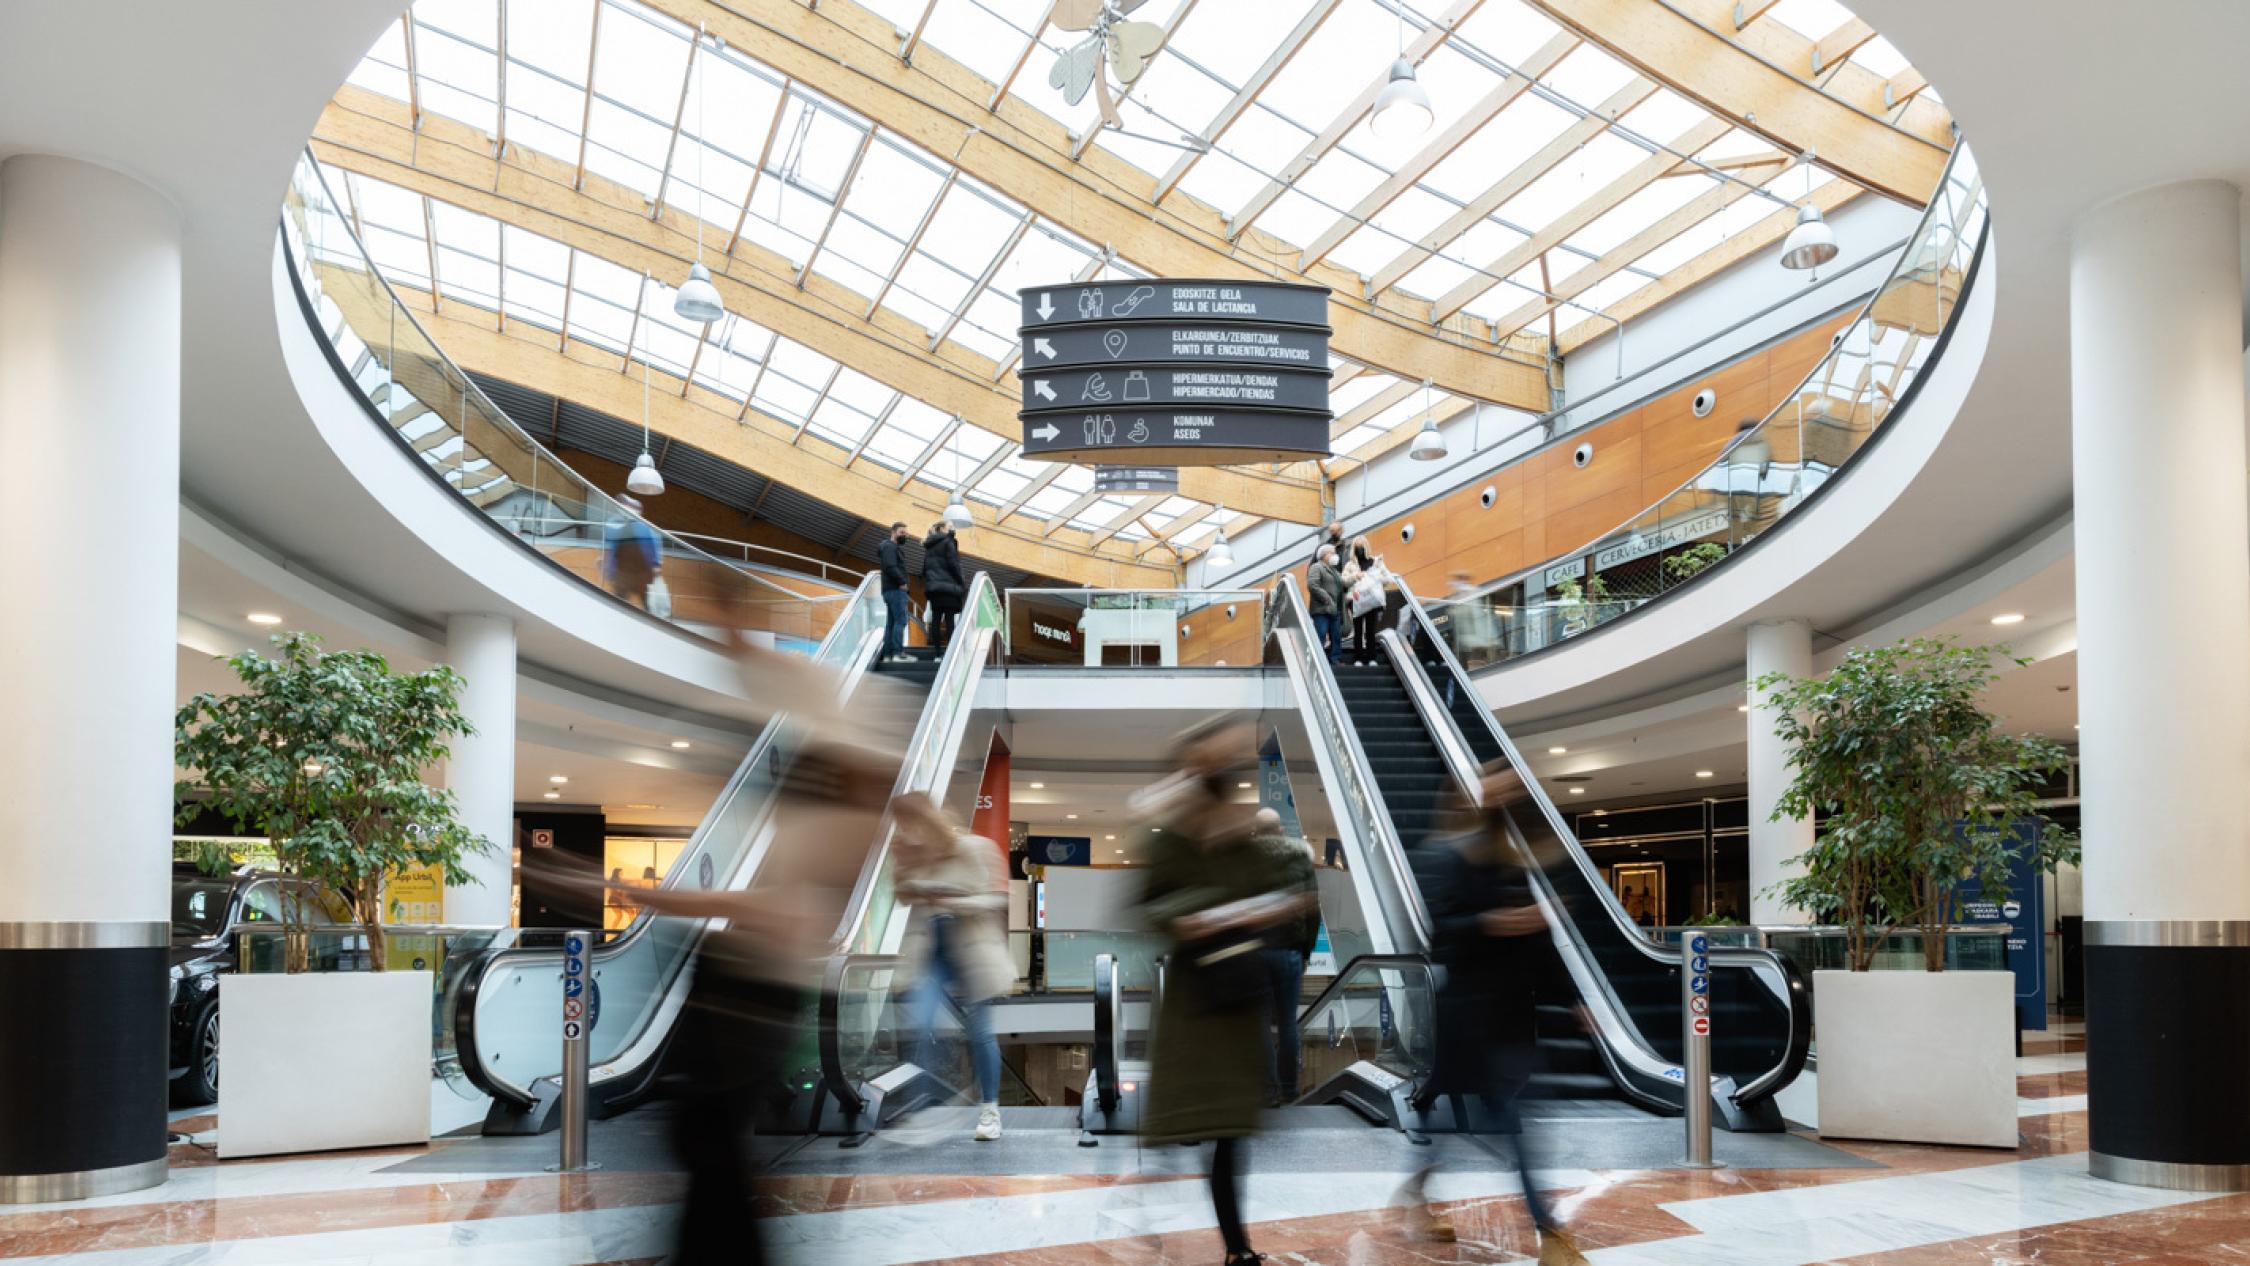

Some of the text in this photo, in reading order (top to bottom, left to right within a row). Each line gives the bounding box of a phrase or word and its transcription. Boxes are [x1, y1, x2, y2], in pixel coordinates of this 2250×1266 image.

[1172, 288, 1217, 300] EDOSKITZE
[1173, 301, 1257, 314] SALA DE LACTANCIA
[1173, 345, 1310, 360] PUNTO DE ENCUENTRO/SERVICIOS
[1173, 386, 1275, 400] HIPERMERCADO/TIENDAS
[1174, 415, 1215, 427] KOMUNAK
[1174, 428, 1201, 440] ASEOS
